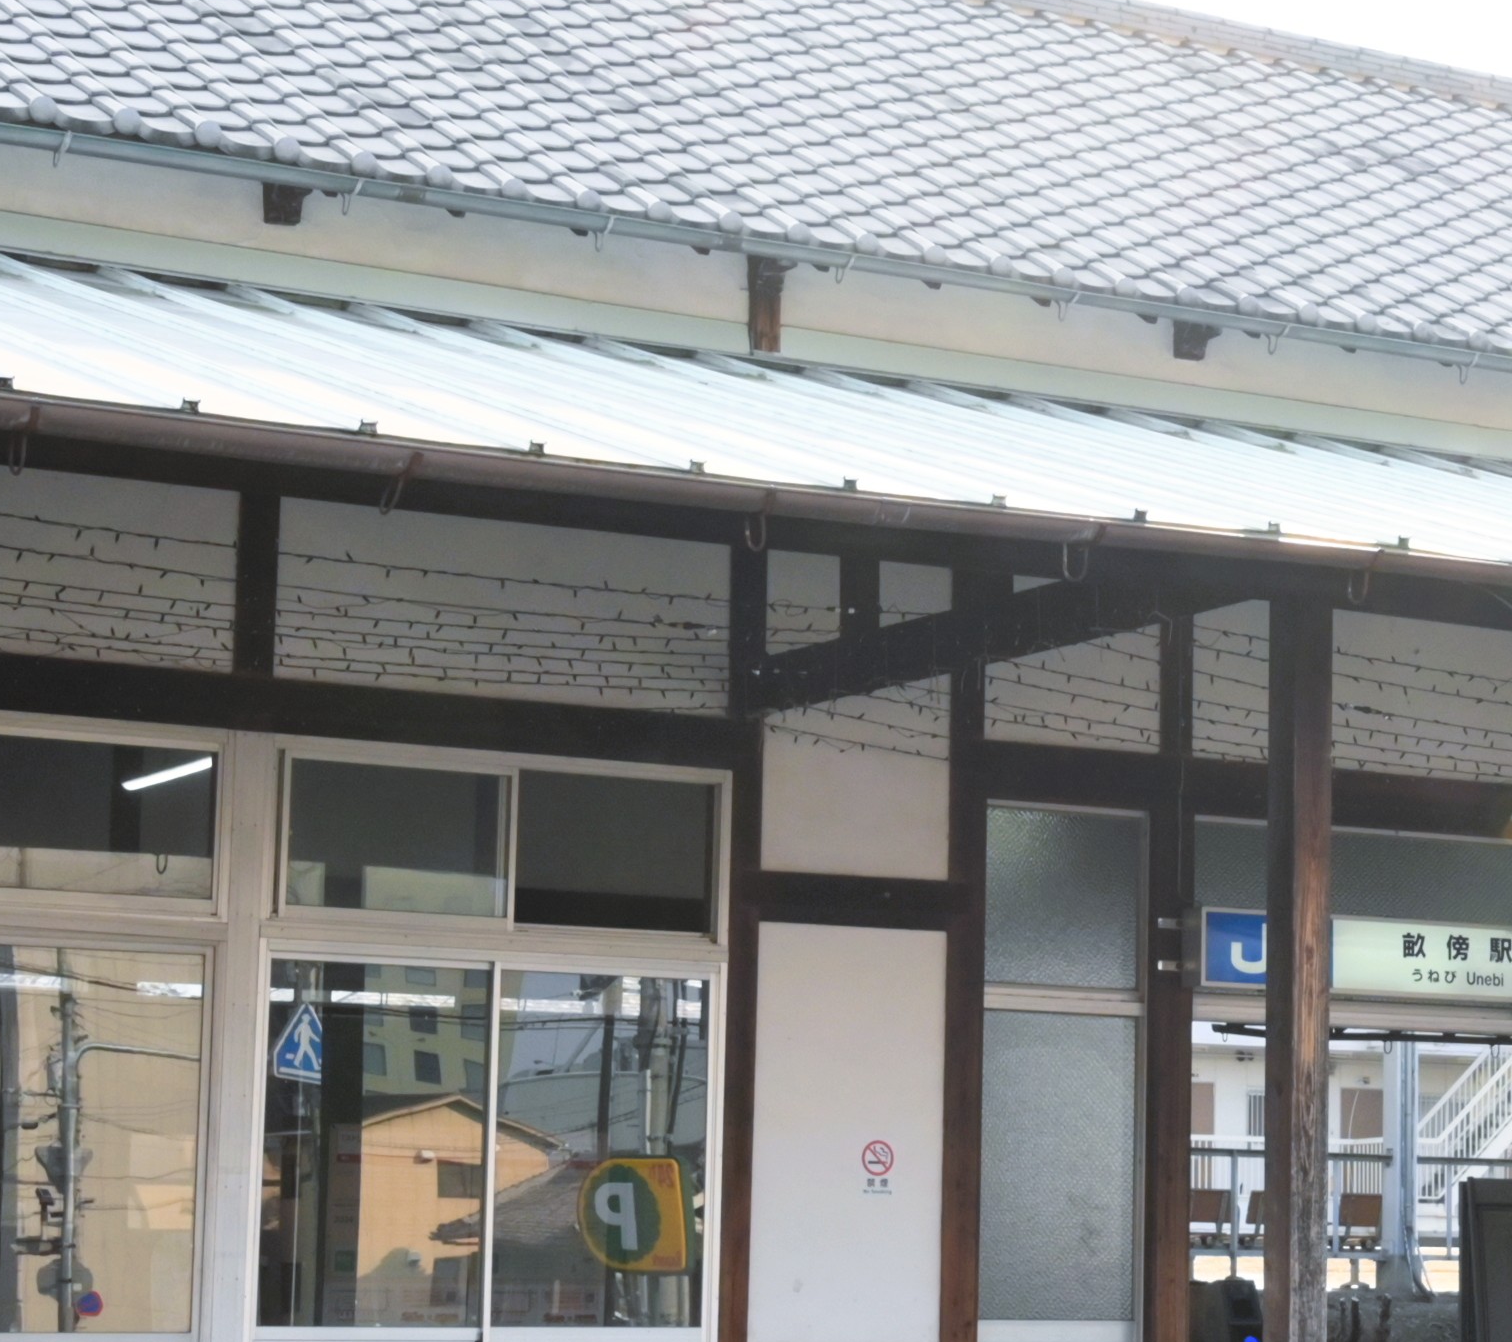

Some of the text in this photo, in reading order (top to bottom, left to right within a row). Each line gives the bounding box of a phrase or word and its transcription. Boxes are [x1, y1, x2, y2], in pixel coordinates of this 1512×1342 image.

[1230, 922, 1267, 974] J
[1402, 932, 1512, 963] 畝傍駅
[1411, 968, 1504, 987] うねび Unebi
